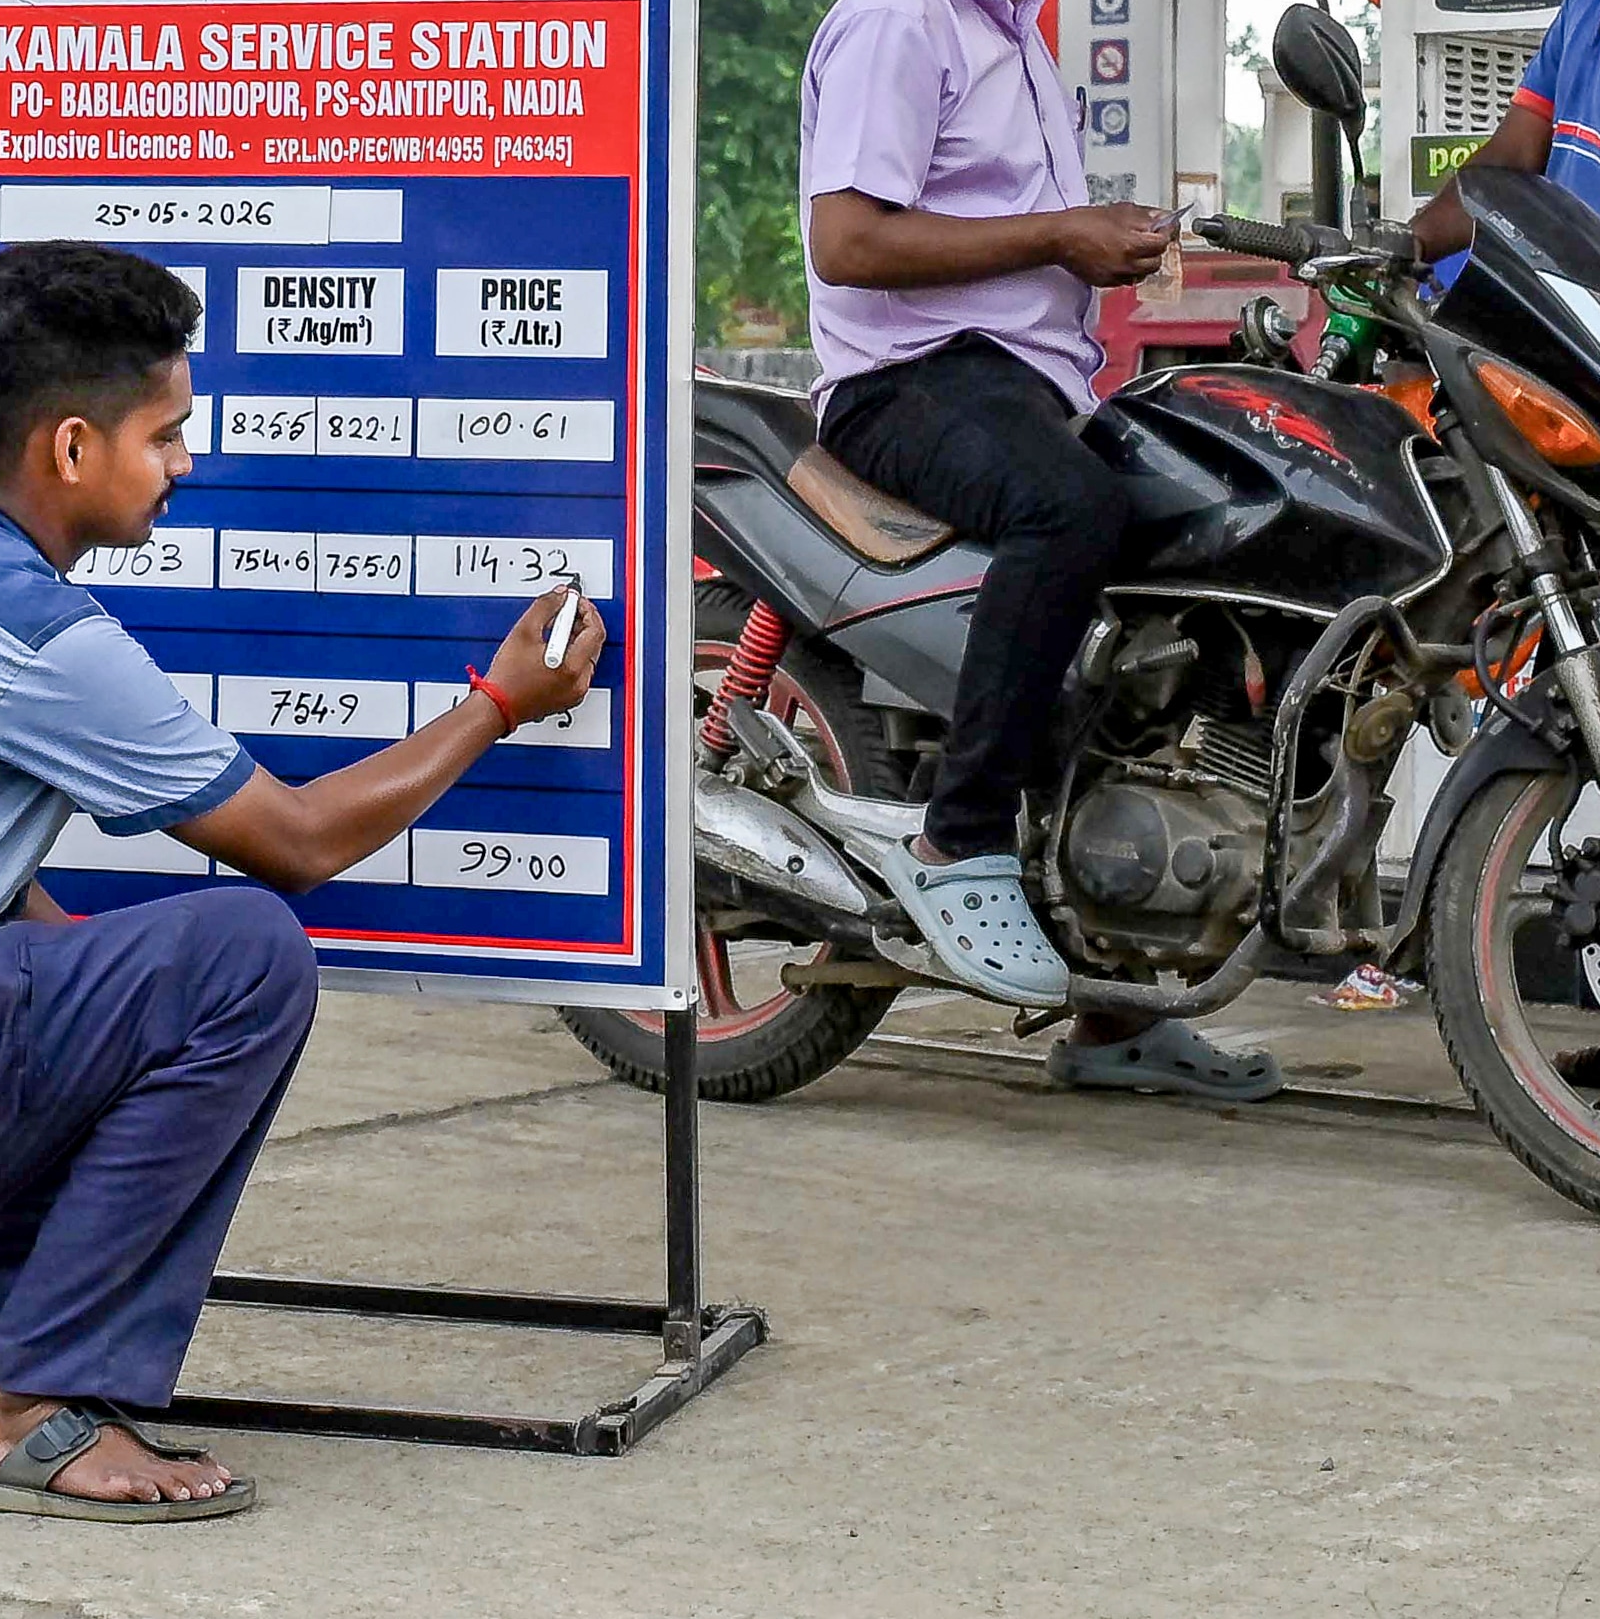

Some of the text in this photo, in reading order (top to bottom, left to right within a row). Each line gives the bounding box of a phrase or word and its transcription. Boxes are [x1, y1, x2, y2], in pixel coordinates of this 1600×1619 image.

[199, 22, 394, 71] SERVICE
[410, 20, 606, 69] STATION
[11, 79, 585, 121] PO- BABLAGOBINDOPUR, PS-SANTIPUR, NADIA
[106, 129, 192, 160] Licence
[198, 129, 235, 160] No.
[494, 135, 573, 168] [P46345]
[263, 276, 377, 309] DENSITY
[481, 278, 562, 312] PRICE
[230, 410, 315, 441] 825.5
[328, 414, 402, 443] 822.1
[456, 411, 567, 443] 100.61
[231, 548, 310, 573] 754.6
[326, 550, 401, 579] 755.0
[269, 690, 359, 727] 754.9
[459, 841, 566, 881] 99.00
